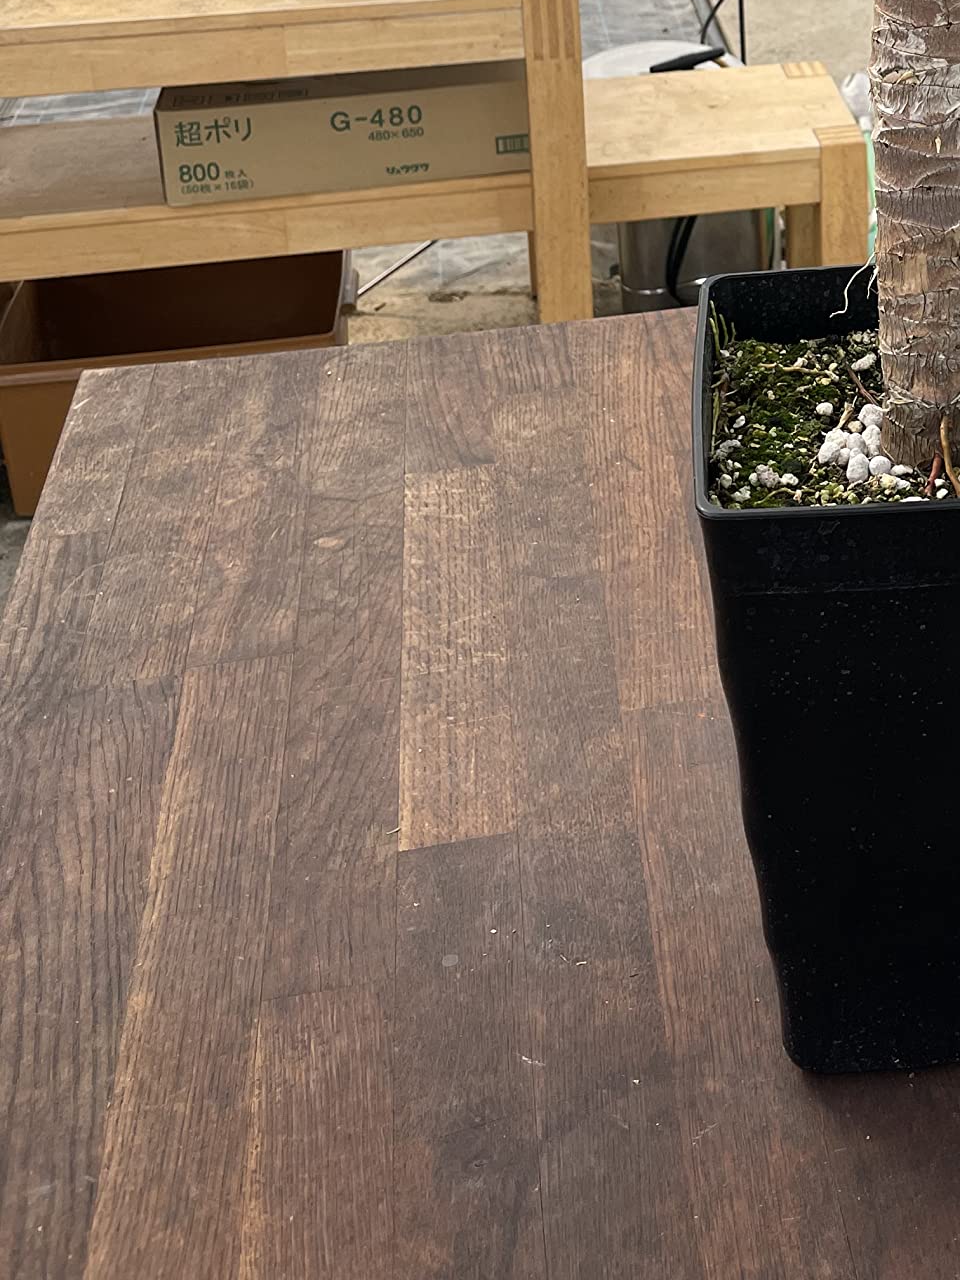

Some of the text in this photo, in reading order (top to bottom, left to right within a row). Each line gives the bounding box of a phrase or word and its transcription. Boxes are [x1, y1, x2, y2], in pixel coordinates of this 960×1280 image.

[174, 116, 252, 147] 超ポリ
[330, 105, 422, 132] G-480
